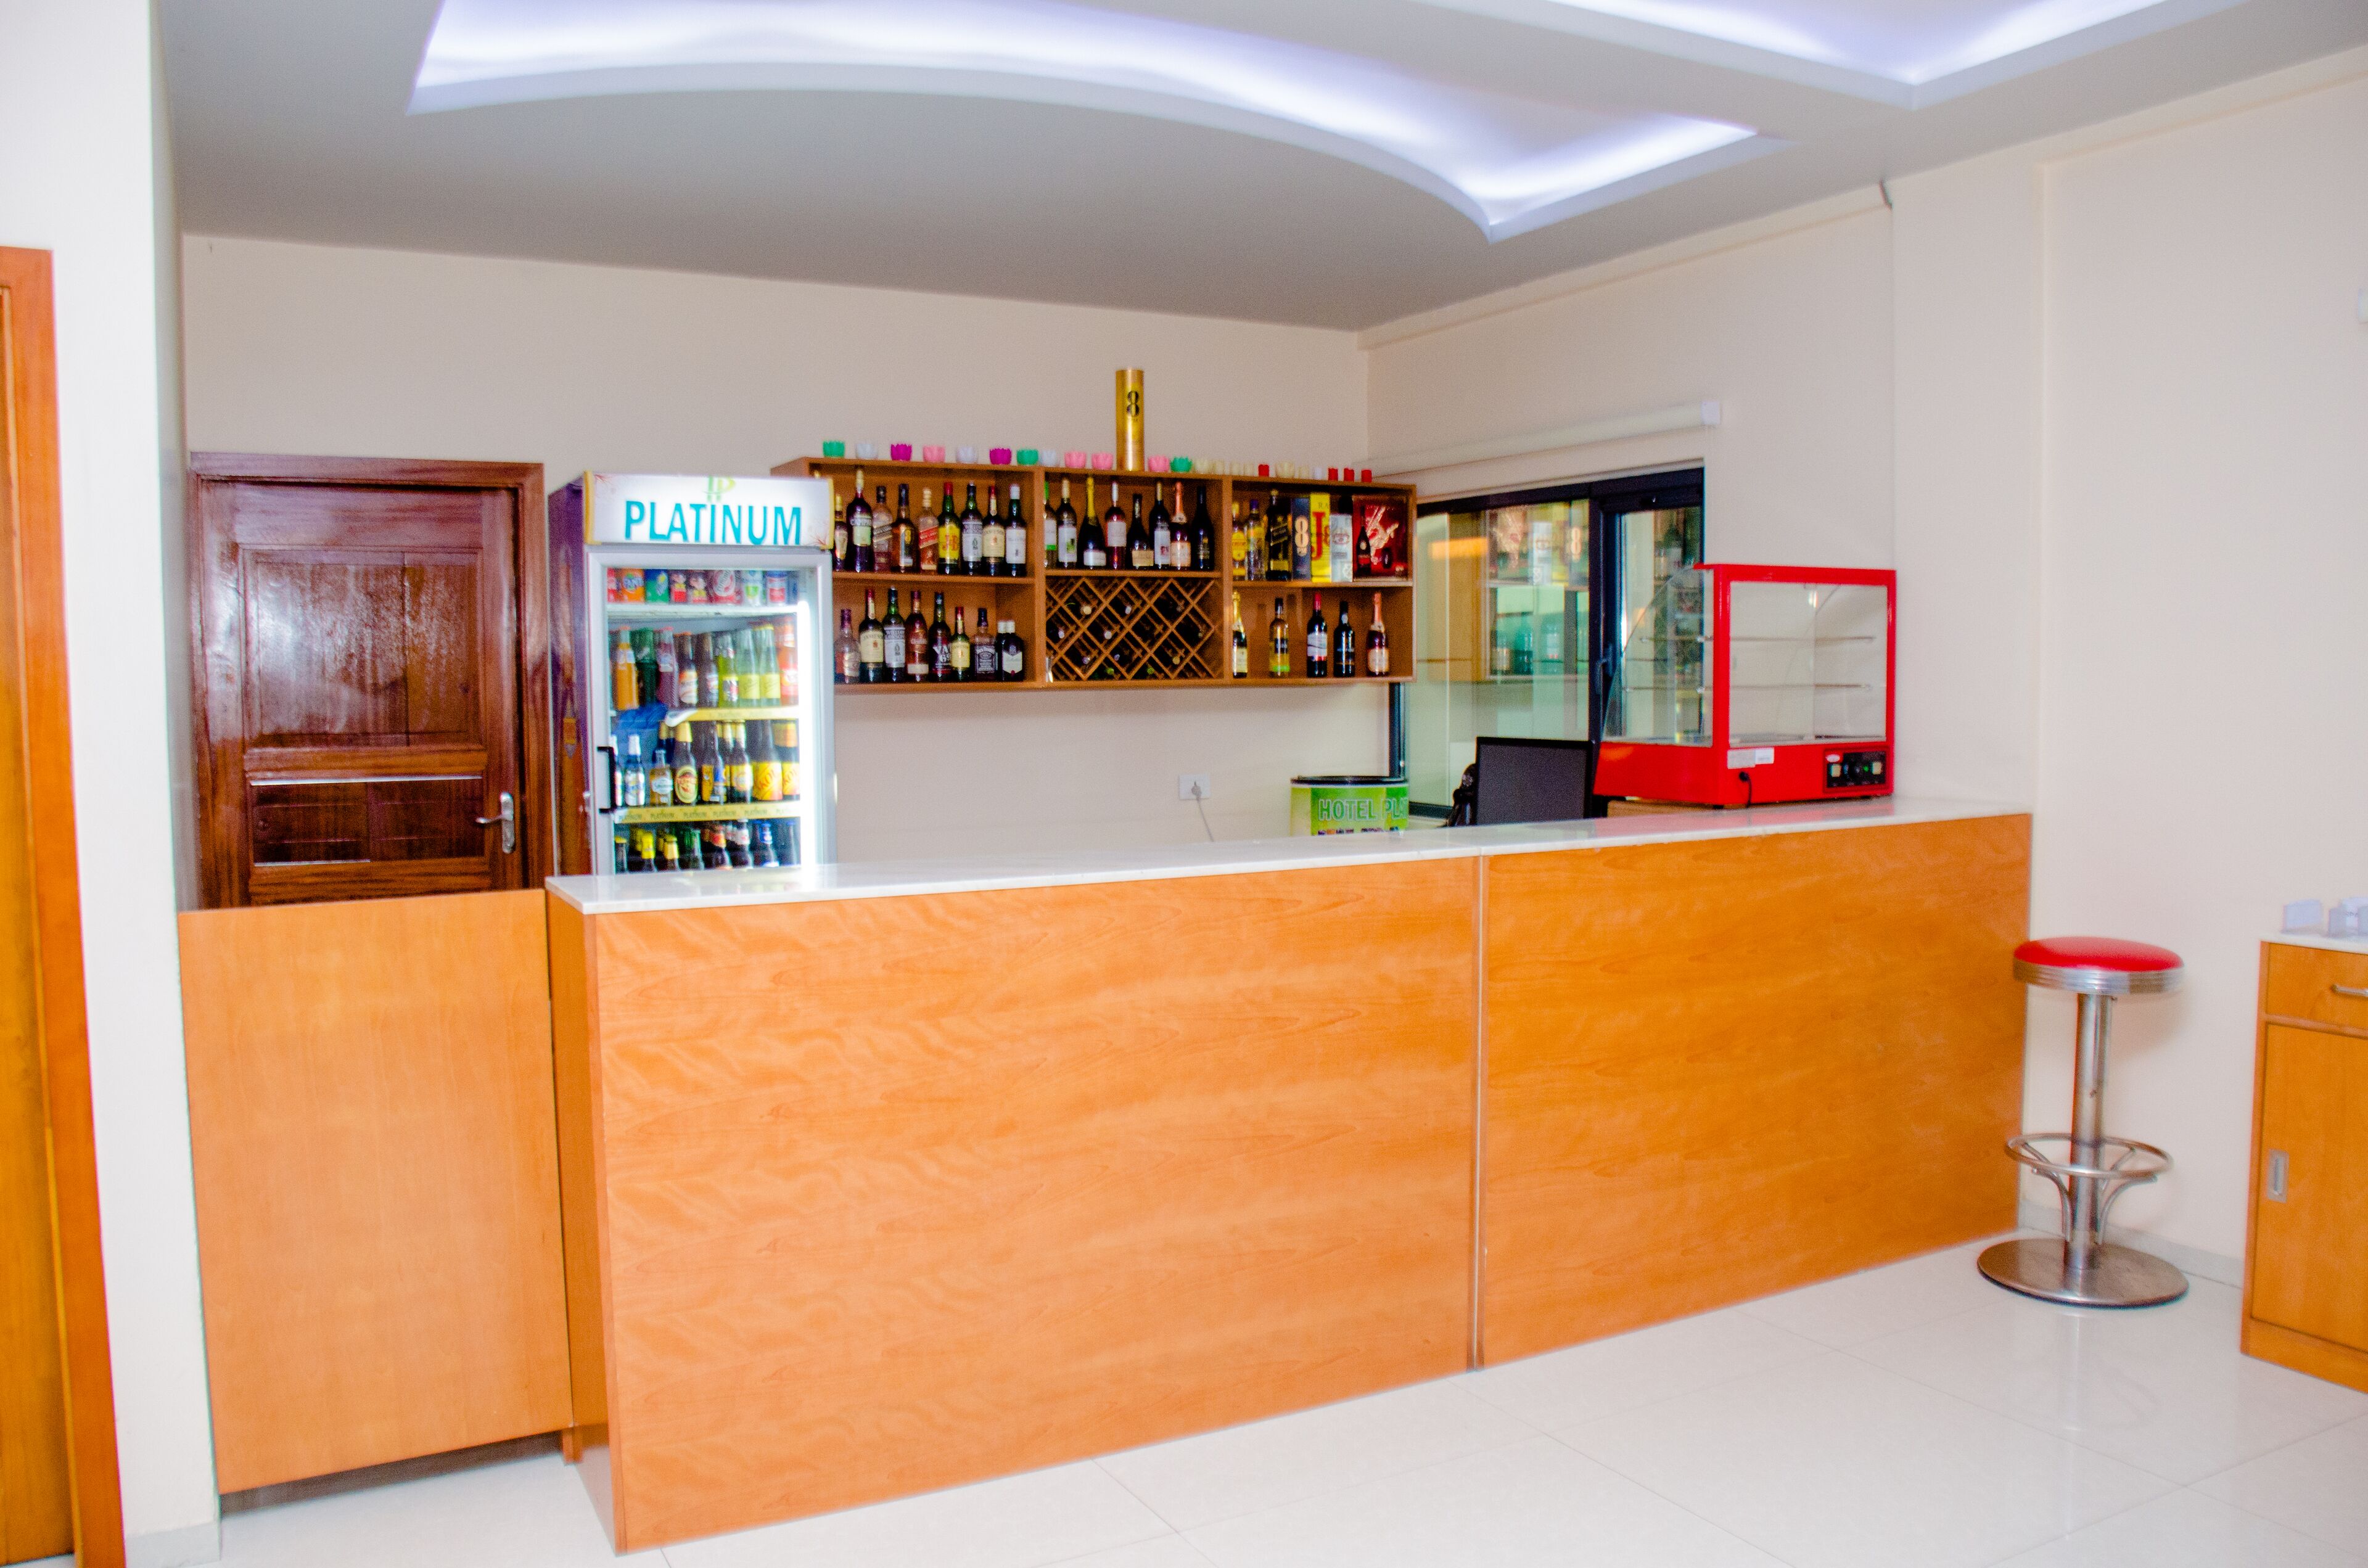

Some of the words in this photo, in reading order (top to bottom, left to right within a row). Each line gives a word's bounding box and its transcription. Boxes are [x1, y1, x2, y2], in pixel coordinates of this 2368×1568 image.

[1127, 391, 1140, 417] 8
[625, 500, 802, 546] PLATINUM
[1295, 515, 1309, 548] 8
[1318, 798, 1378, 821] HOTEL
